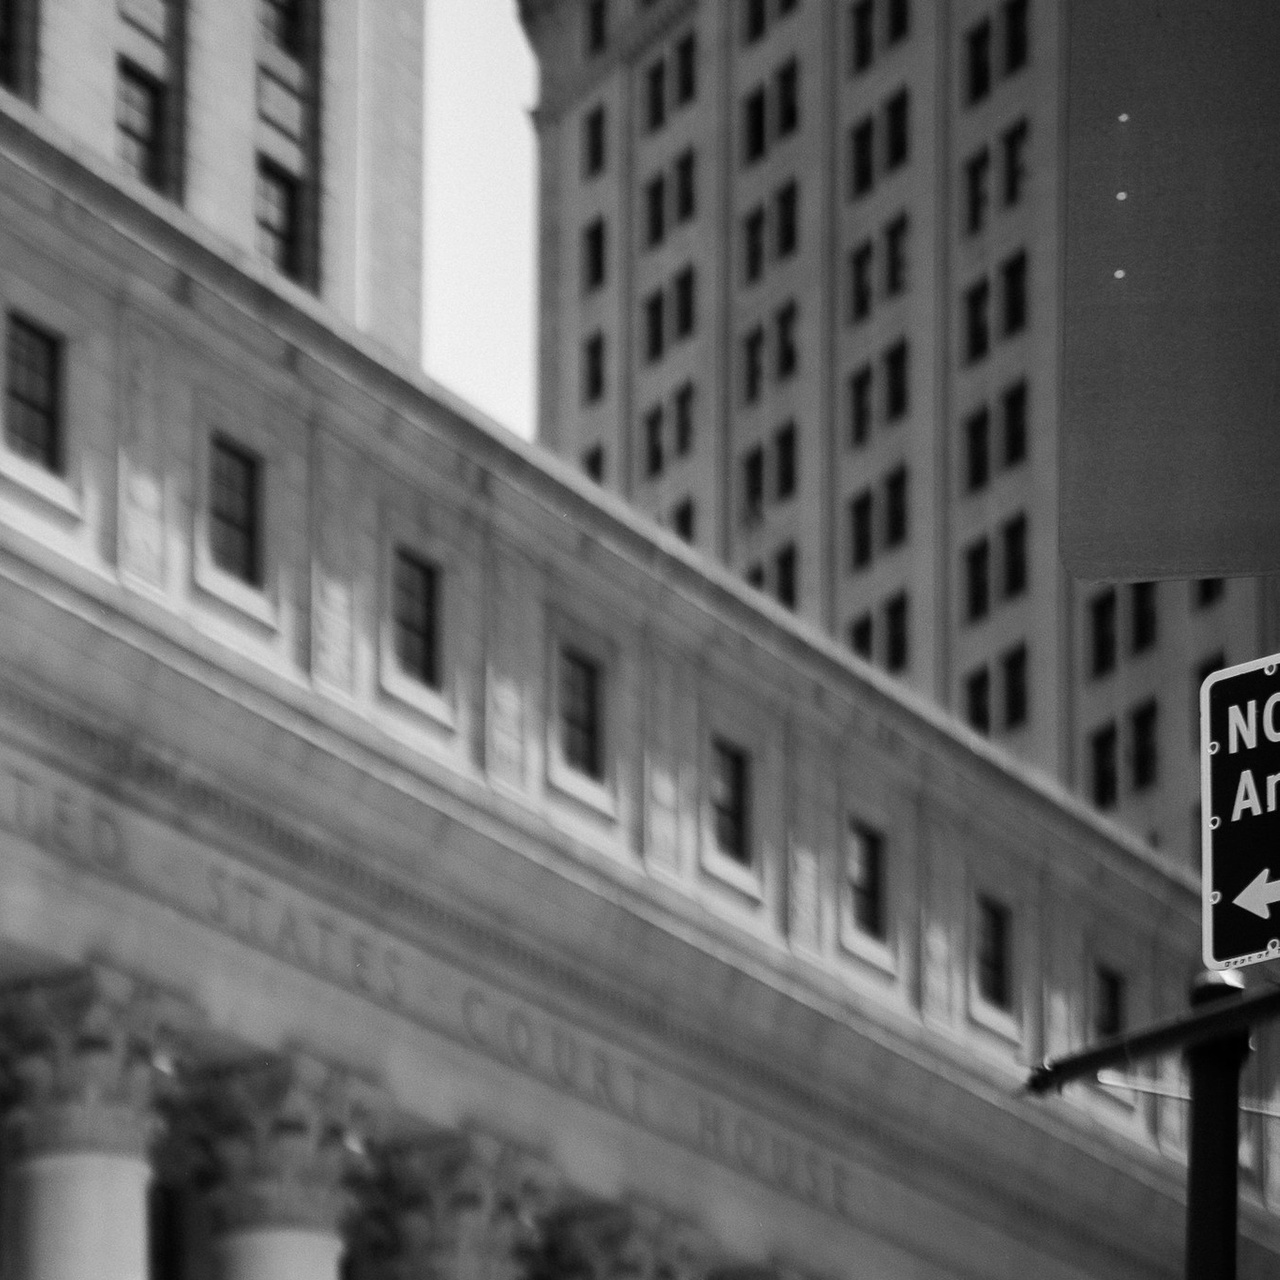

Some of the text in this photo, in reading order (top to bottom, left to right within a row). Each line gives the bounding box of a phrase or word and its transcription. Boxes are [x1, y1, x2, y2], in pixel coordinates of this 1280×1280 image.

[207, 866, 401, 1004] STATES
[462, 987, 647, 1108] COURT
[698, 1099, 847, 1216] HOUSE
